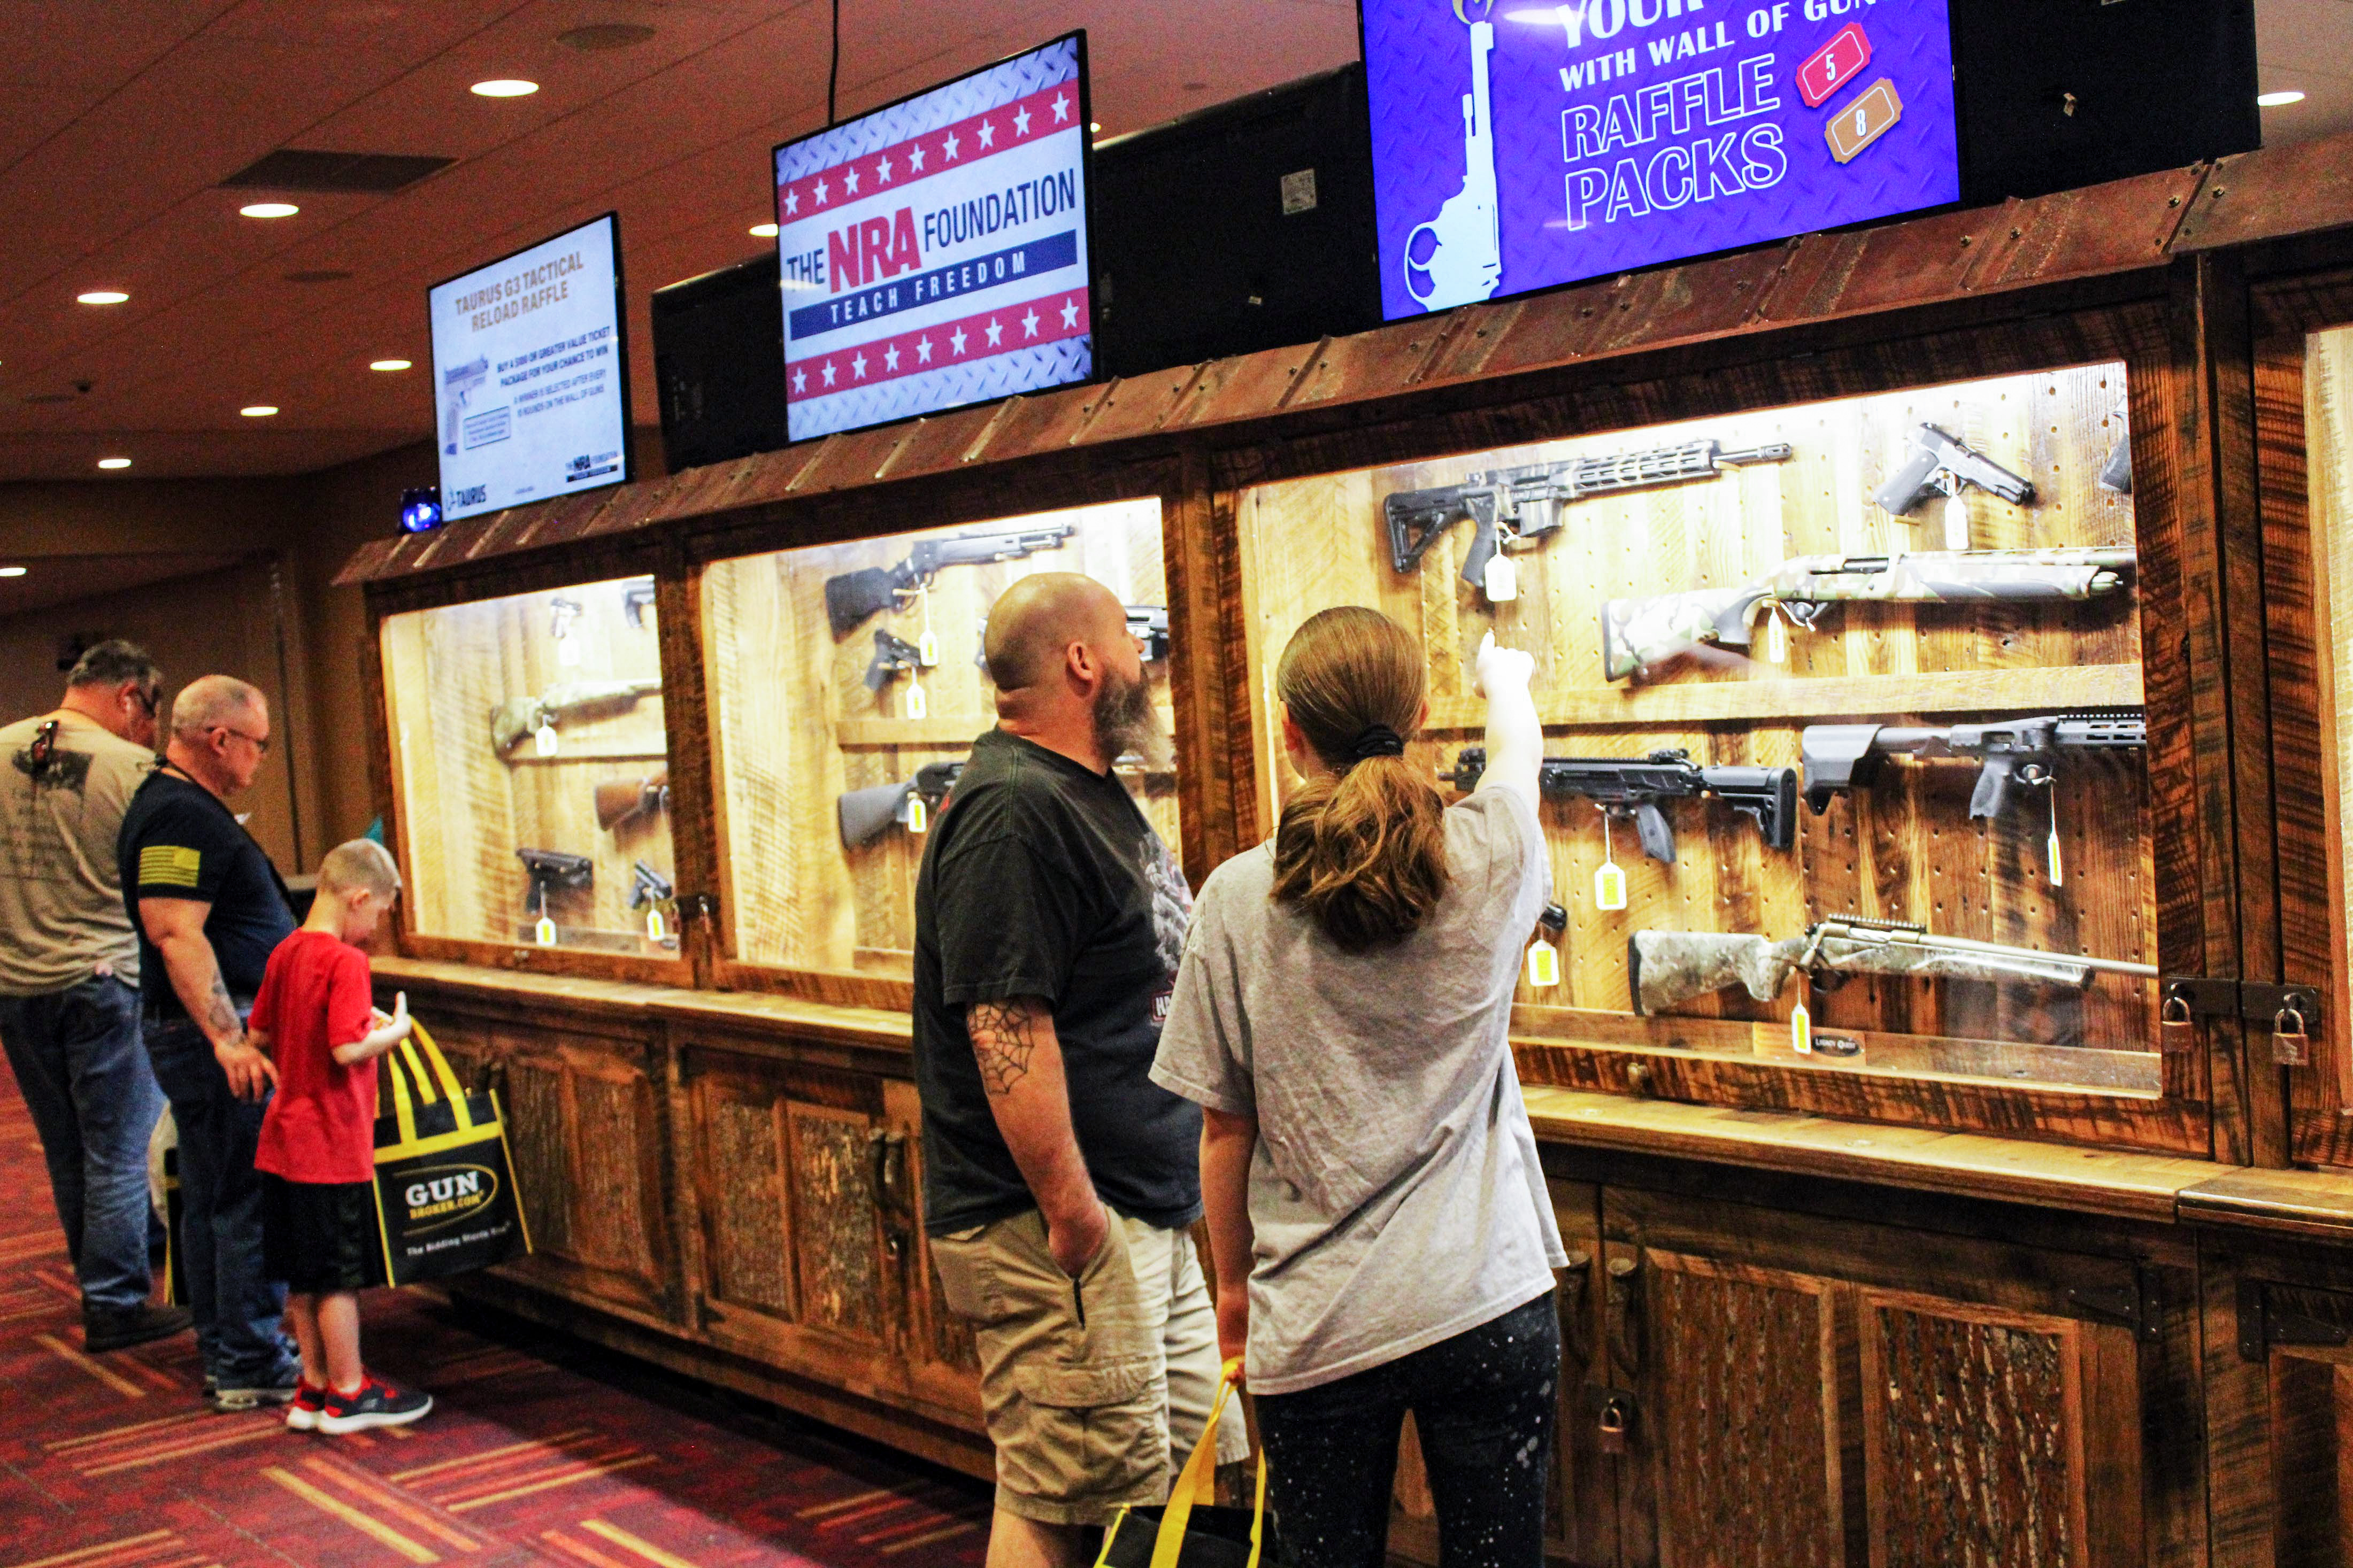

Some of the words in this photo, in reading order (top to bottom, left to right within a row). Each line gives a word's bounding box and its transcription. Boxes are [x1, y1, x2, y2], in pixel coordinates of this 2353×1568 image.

[1559, 48, 1635, 91] WITH
[1648, 21, 1734, 66] WALL
[1747, 2, 1789, 38] OF
[1826, 53, 1836, 81] 5
[1562, 52, 1781, 163] RAFFLE
[1856, 109, 1866, 136] 8
[1565, 123, 1787, 231] PACKS
[787, 248, 825, 291] THE
[828, 206, 922, 293] NRA
[924, 168, 1075, 252] FOUNDATION
[456, 283, 502, 315] TAURUS
[504, 276, 521, 297] G3
[522, 251, 583, 291] TACTICAL
[472, 300, 519, 332] RELOAD
[521, 280, 568, 314] RAFFLE
[831, 289, 897, 323] TEACH
[916, 250, 1025, 301] FREEDOM
[457, 484, 486, 508] TAURUS
[405, 1171, 480, 1207] GUN
